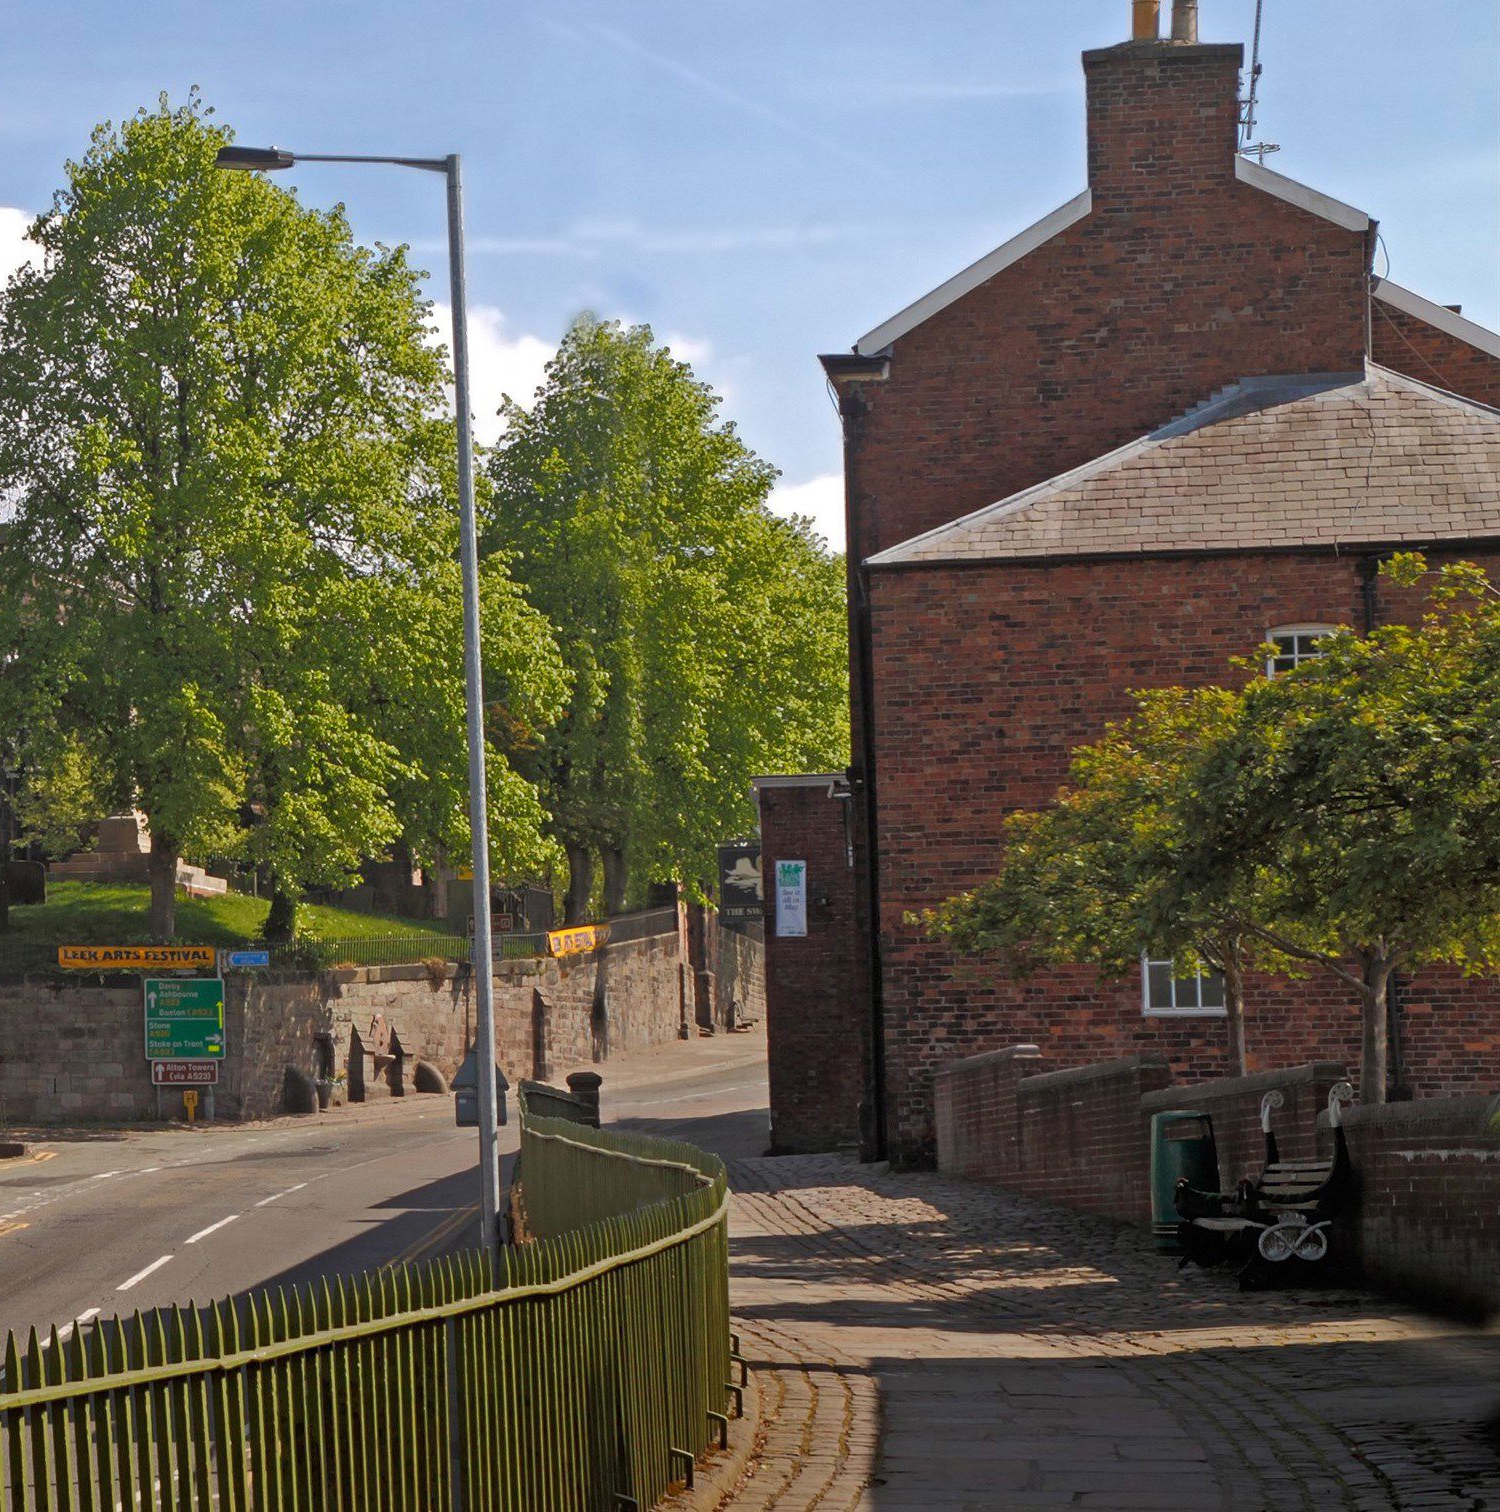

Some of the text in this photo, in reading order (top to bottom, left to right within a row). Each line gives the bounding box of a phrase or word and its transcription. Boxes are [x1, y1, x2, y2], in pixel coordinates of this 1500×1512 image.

[726, 908, 745, 916] THE
[64, 949, 210, 961] LEEK ARTS FESTIVAL
[149, 1040, 172, 1048] Stoke
[184, 1040, 204, 1048] Trent
[188, 1063, 214, 1071] Towers
[169, 1072, 211, 1080] (via A523)
